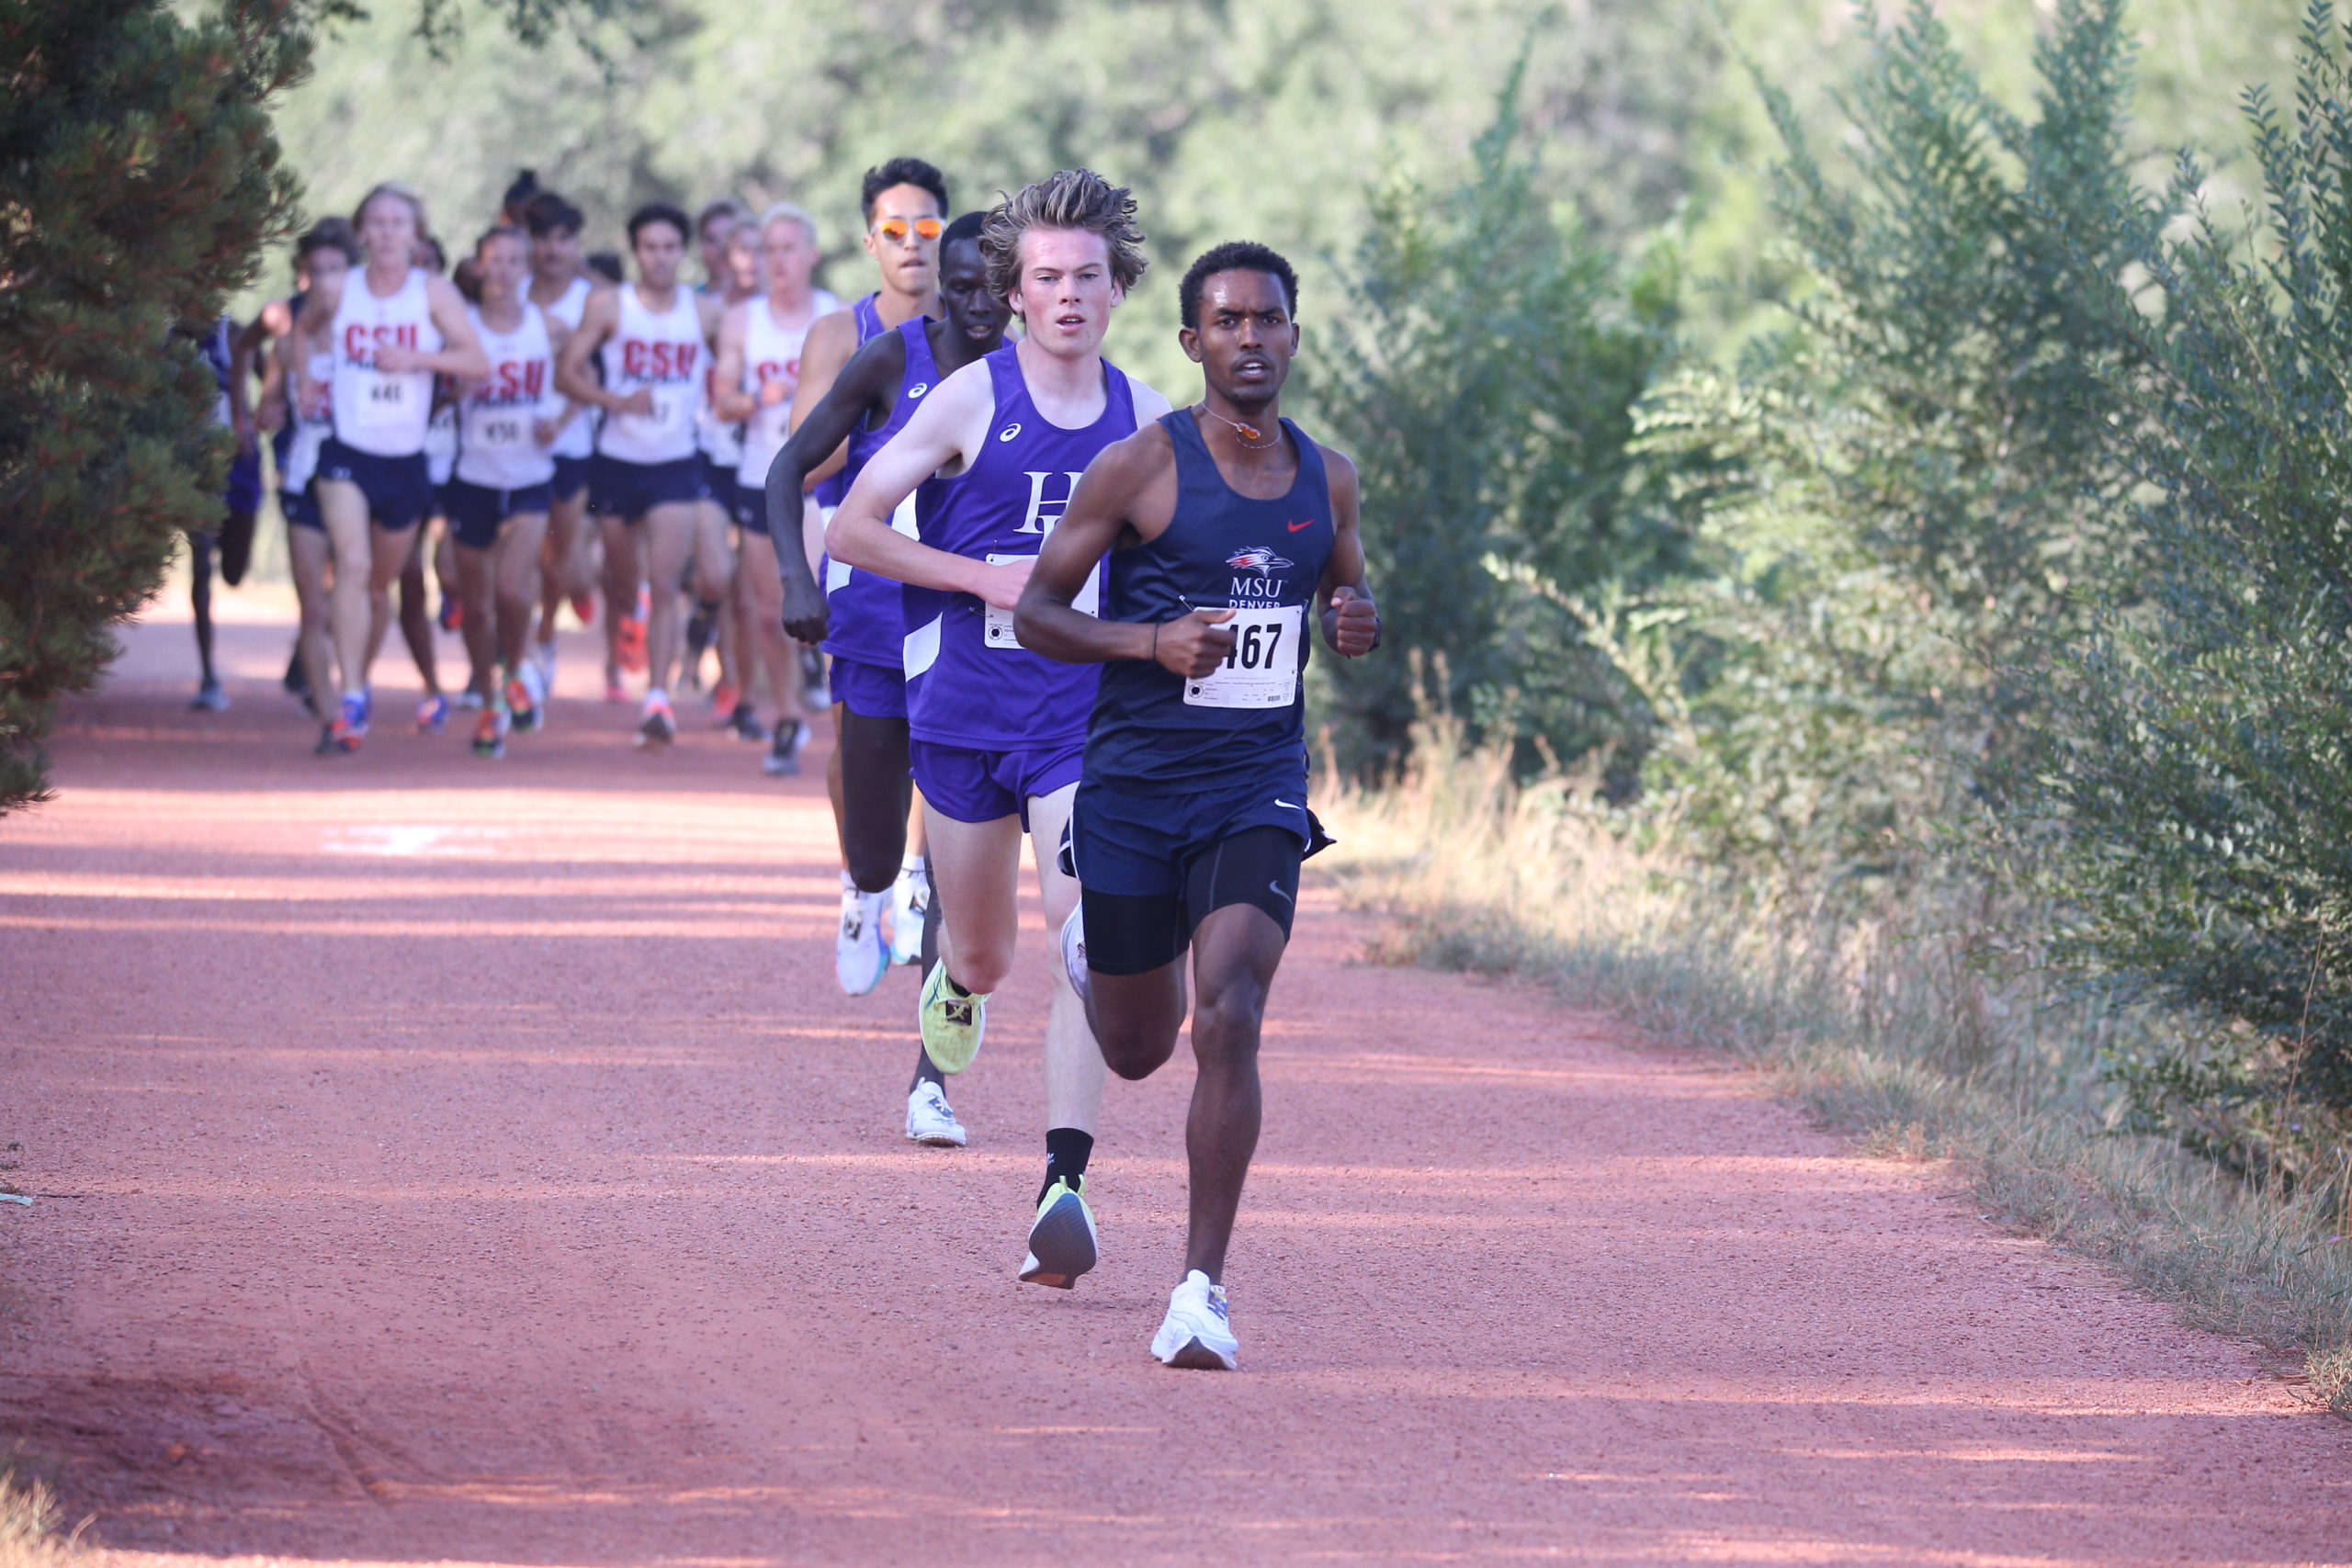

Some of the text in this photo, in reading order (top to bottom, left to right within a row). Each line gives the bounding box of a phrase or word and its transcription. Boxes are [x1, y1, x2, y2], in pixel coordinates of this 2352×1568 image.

[623, 339, 697, 377] CSU
[1230, 577, 1282, 597] MSU
[1228, 599, 1281, 609] DENVER
